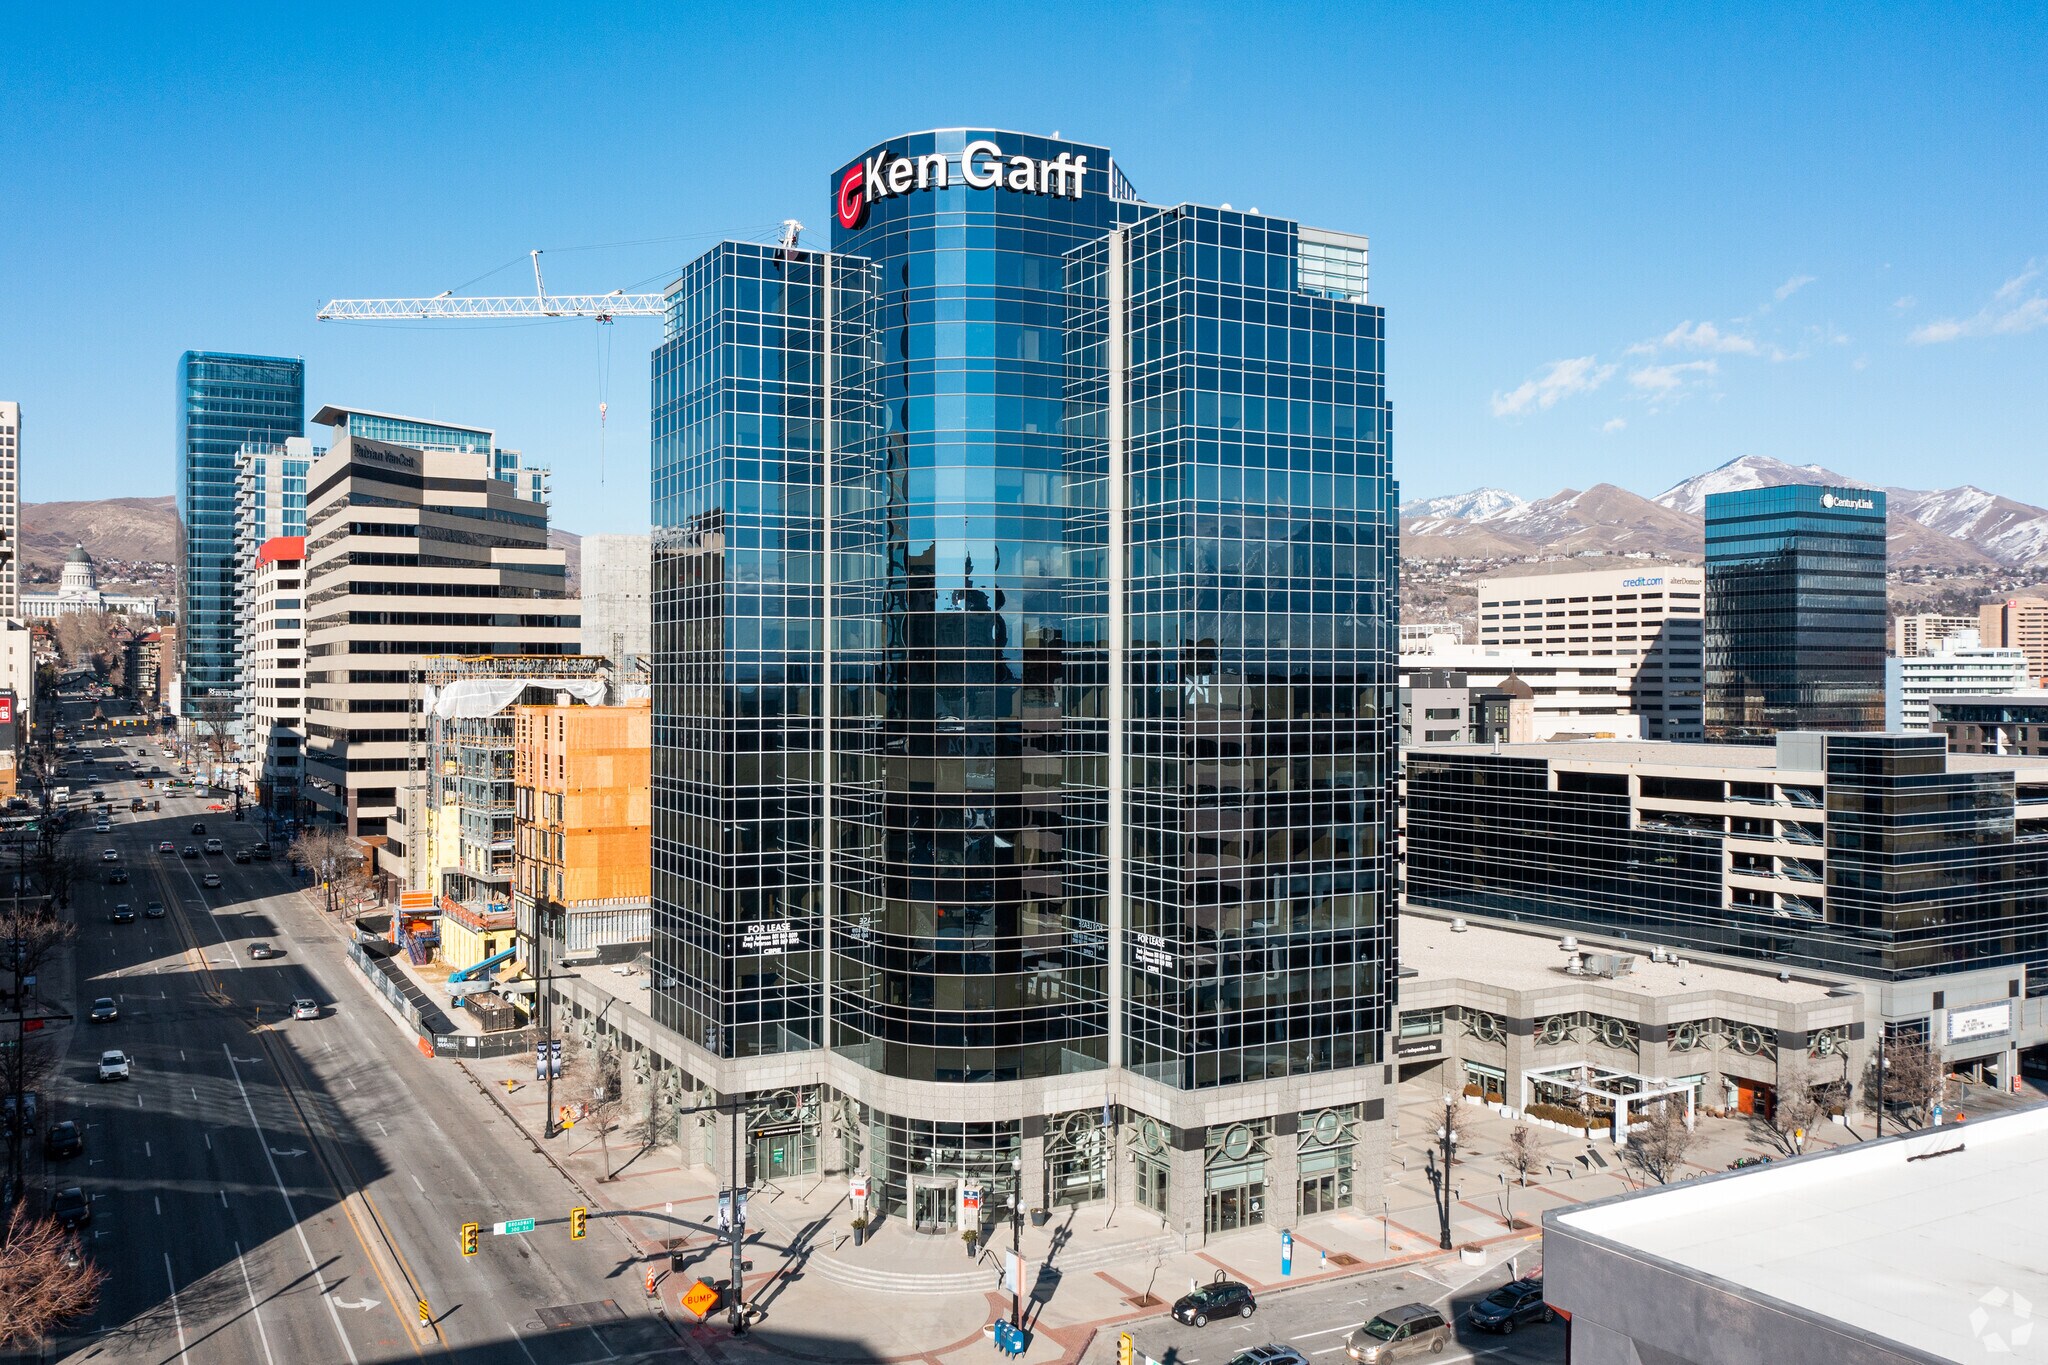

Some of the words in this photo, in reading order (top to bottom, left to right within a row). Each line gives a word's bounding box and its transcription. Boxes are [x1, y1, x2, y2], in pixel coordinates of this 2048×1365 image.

[865, 149, 948, 203] Ken
[961, 140, 1087, 199] Garff
[354, 443, 383, 461] Fabian
[1833, 497, 1873, 510] CenturyLink
[1623, 577, 1663, 587] credit.com
[748, 925, 765, 934] FOR
[767, 923, 791, 932] LEASE
[1138, 934, 1148, 944] FOR
[1149, 936, 1165, 947] LEASE
[688, 1294, 712, 1304] BUMP
